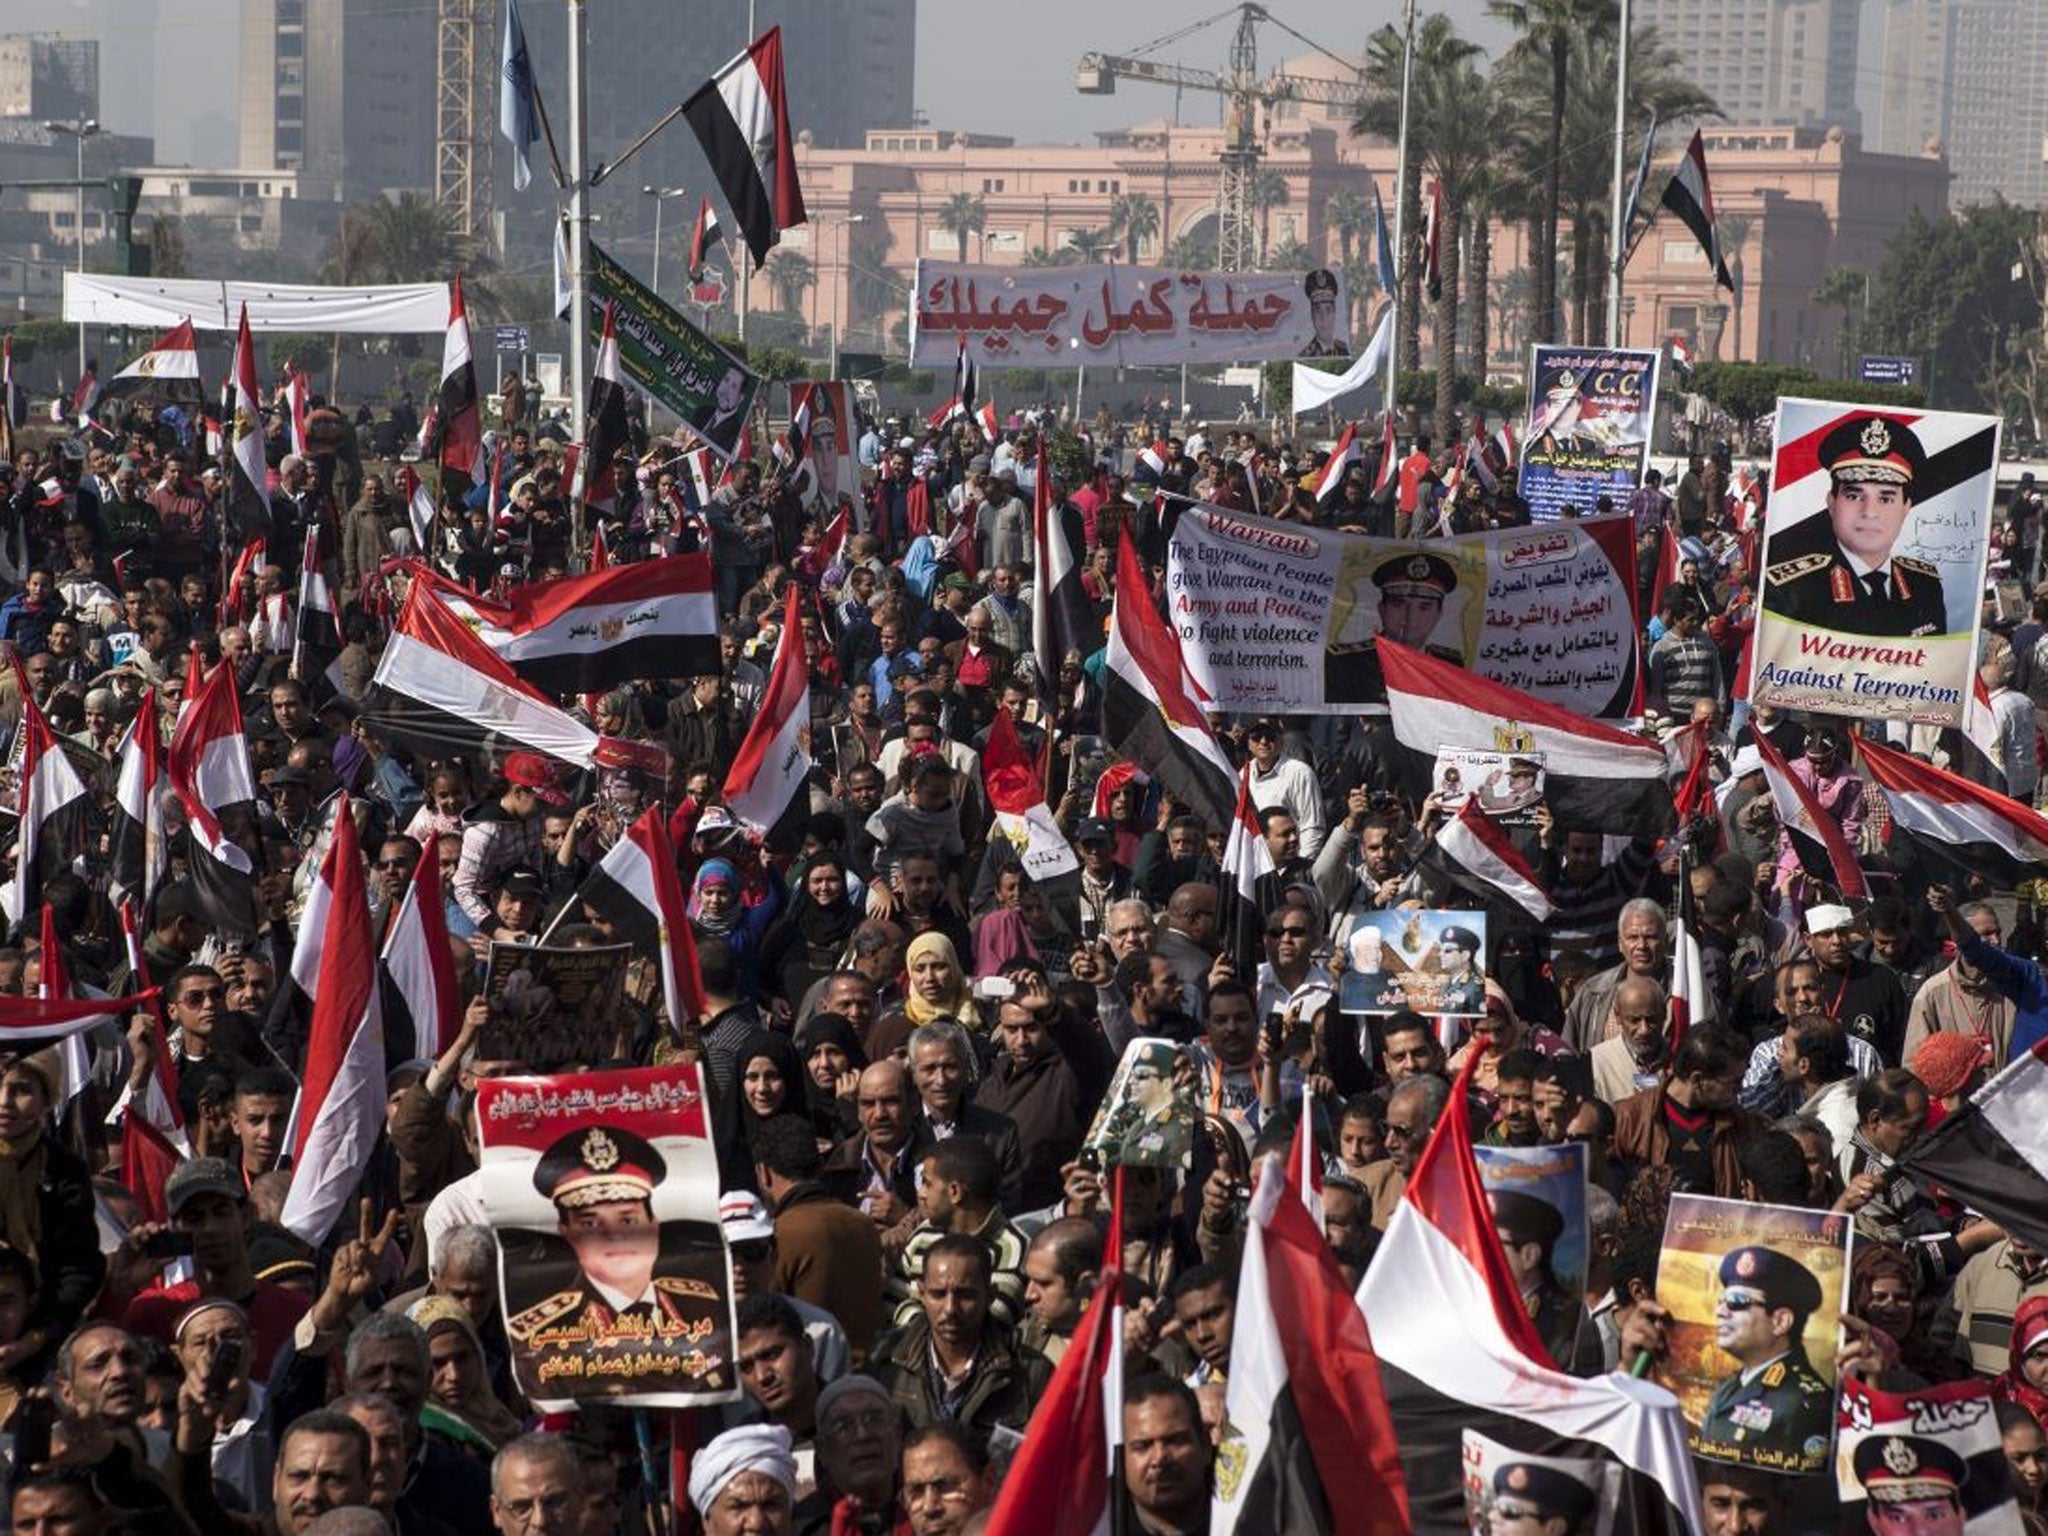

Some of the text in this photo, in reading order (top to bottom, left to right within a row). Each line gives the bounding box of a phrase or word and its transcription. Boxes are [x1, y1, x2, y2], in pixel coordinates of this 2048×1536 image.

[918, 273, 1292, 352] حملة كمل جميلك
[1207, 511, 1310, 554] Warrant
[1170, 541, 1334, 588] The Egyptian People
[1505, 534, 1569, 564] تفويض
[1535, 563, 1572, 589] الشعب
[1575, 559, 1611, 587] يفوض
[1172, 570, 1329, 609] give Warrant to the
[1176, 594, 1322, 624] Army and Police
[1486, 595, 1612, 632] الجيش والشرطة
[1199, 621, 1238, 642] fight
[1243, 622, 1320, 642] violence
[1557, 632, 1619, 659] بالتعامل
[1208, 650, 1308, 669] and terrorism.
[1532, 643, 1552, 664] مع
[1801, 633, 1927, 667] Warrant
[1535, 668, 1581, 691] والعنف
[1758, 661, 1961, 704] Against Terrorism
[598, 1312, 654, 1349] بالمشير
[655, 1306, 714, 1346] مرحبا
[538, 1354, 584, 1386] العالم
[636, 1352, 680, 1376] ميدان
[1906, 1398, 1990, 1435] حملة
[1752, 1446, 1783, 1466] الدنيا
